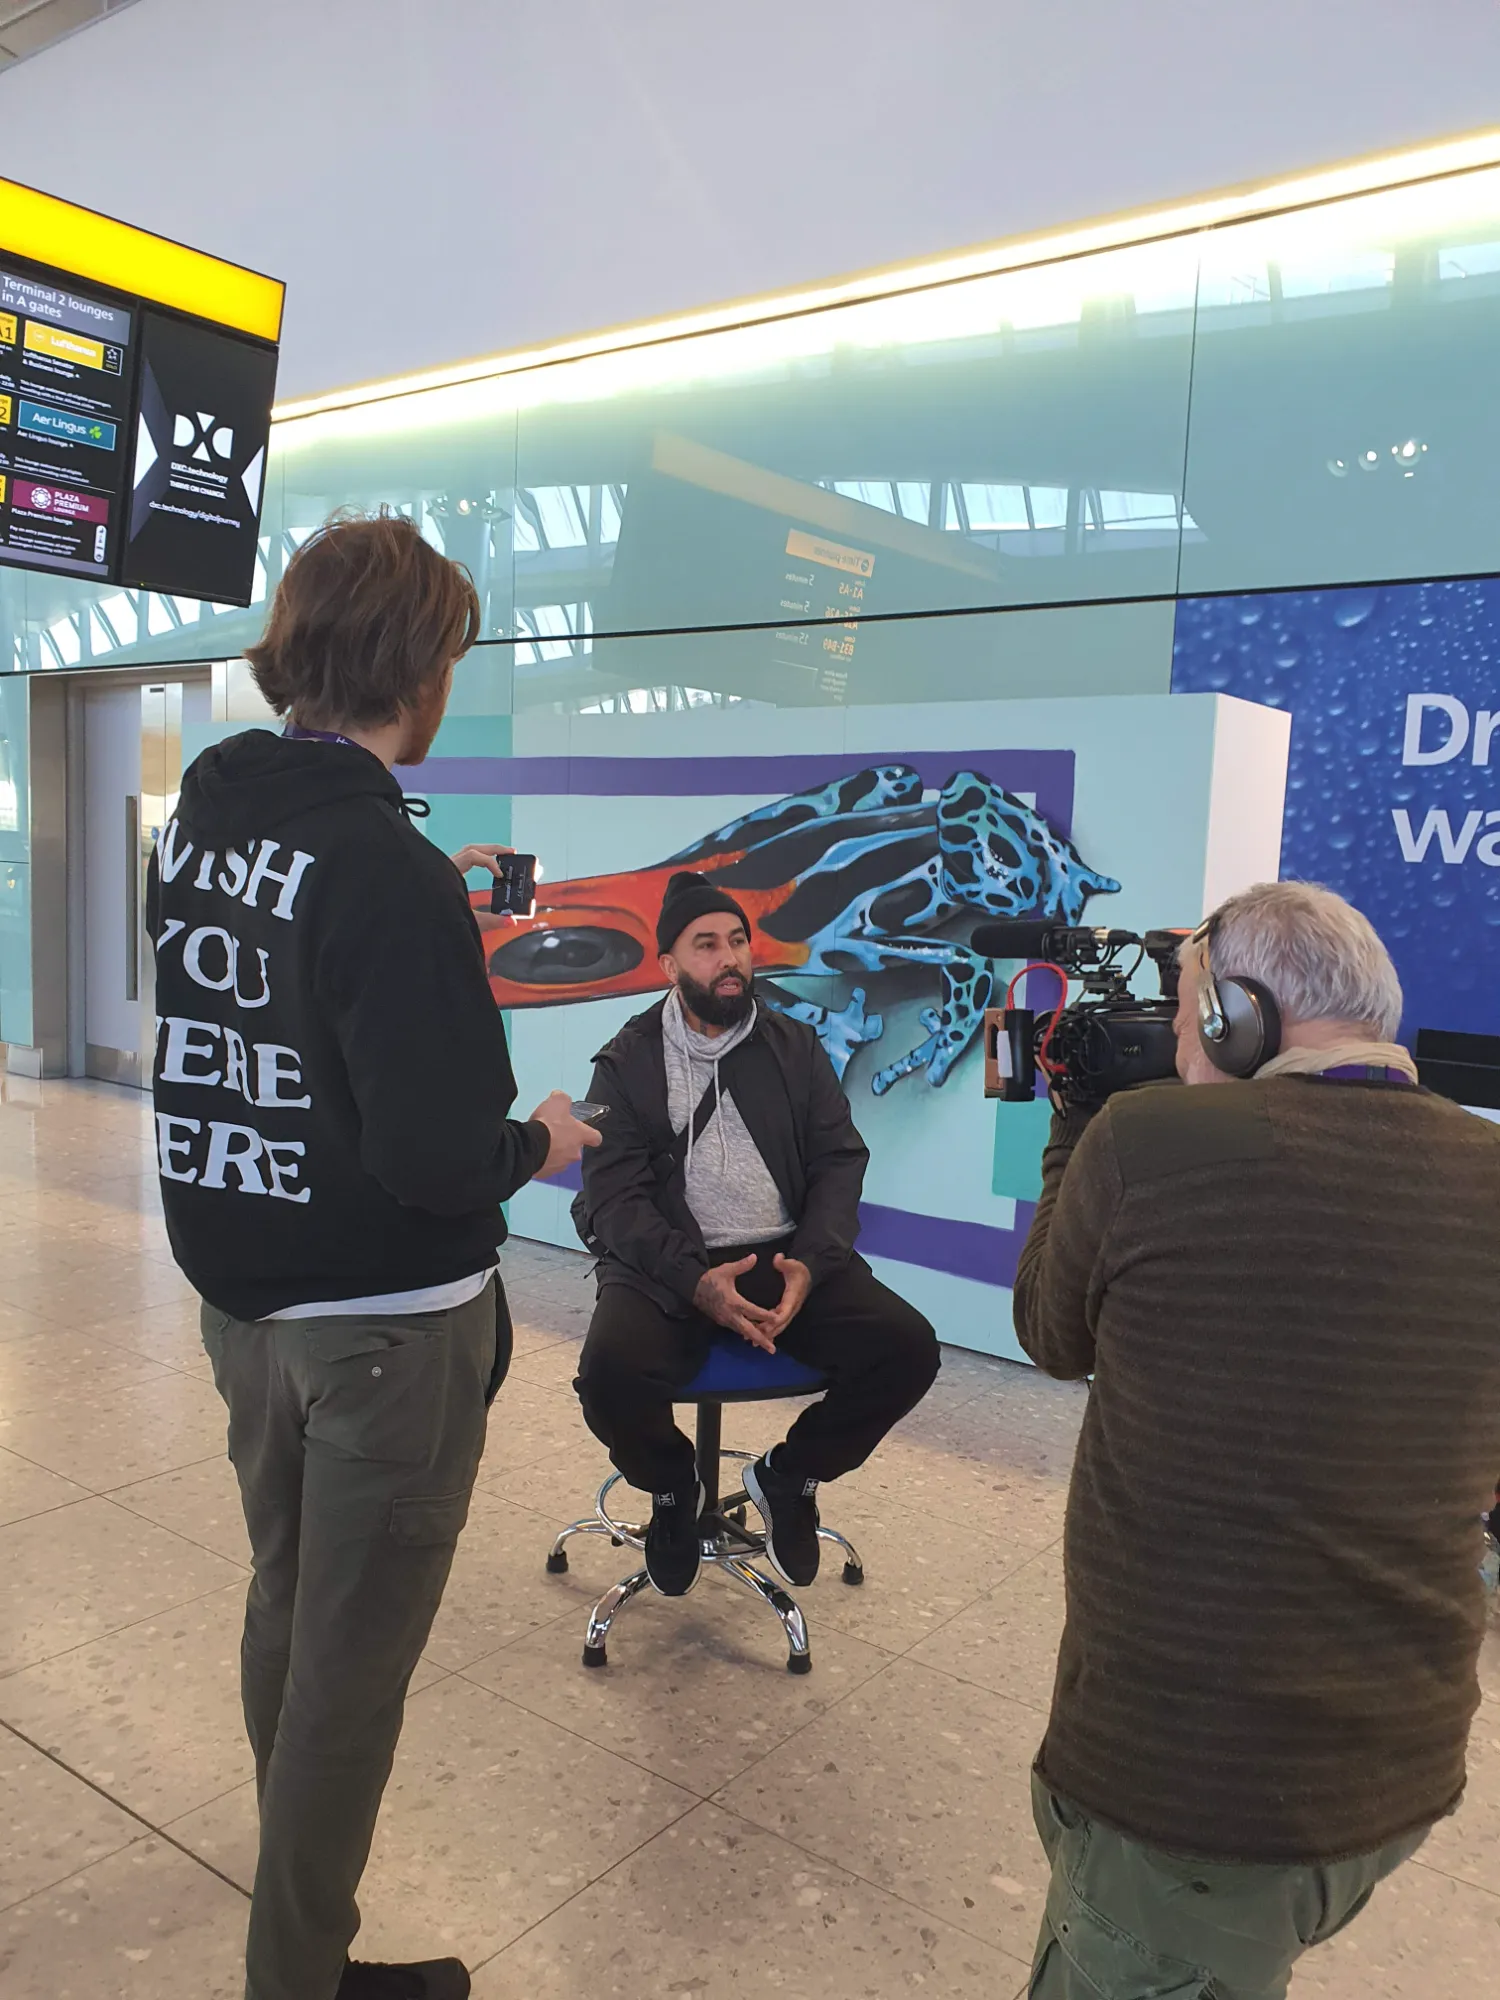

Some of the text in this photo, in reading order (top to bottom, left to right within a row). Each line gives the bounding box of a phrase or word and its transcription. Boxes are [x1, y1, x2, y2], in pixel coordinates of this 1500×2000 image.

[2, 276, 115, 321] Terminal 2 lounges
[2, 290, 62, 318] in A gates
[50, 336, 97, 357] Lufthansa
[32, 413, 87, 434] Aer Lingus
[54, 499, 90, 513] PREMIUM
[55, 491, 80, 503] PLAZA
[11, 508, 27, 516] Plaza
[27, 511, 53, 521] Premium
[156, 818, 315, 921] WISH
[155, 1015, 312, 1110] ERE
